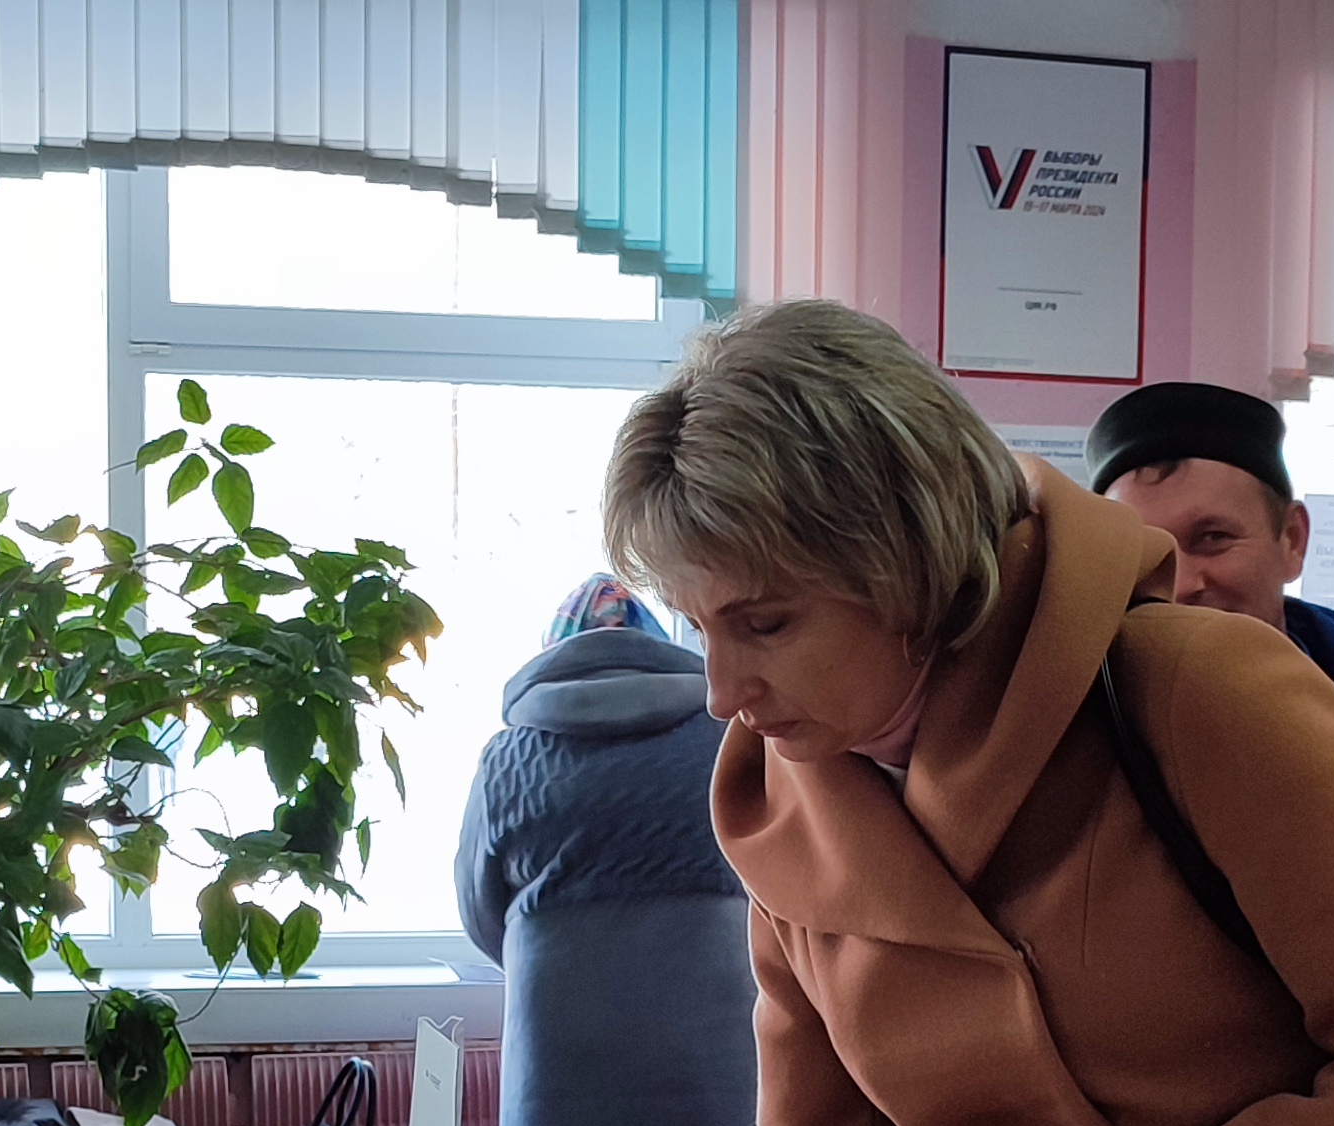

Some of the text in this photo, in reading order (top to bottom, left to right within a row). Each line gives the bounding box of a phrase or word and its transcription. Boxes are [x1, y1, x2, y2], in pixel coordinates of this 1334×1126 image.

[1042, 150, 1103, 166] ВЫБОРЫ
[1035, 167, 1119, 185] ПРЕЗИДЕНТА
[1028, 184, 1083, 199] РОССИИ
